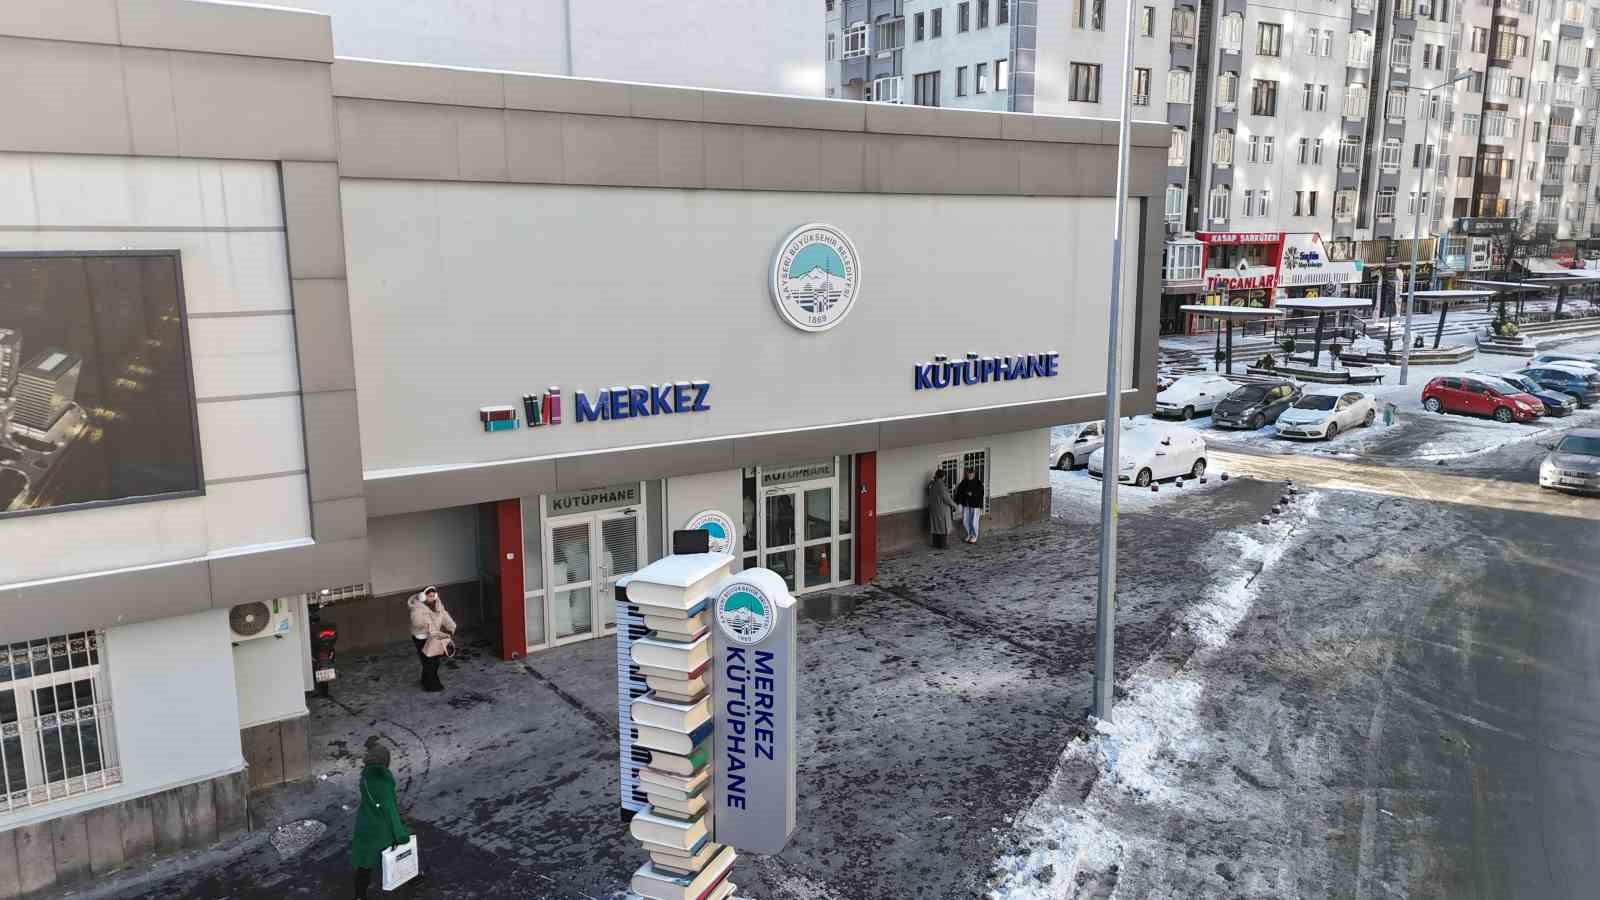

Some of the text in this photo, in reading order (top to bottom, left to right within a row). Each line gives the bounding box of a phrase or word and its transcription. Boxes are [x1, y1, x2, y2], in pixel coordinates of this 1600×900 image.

[575, 352, 1059, 422] MERKEZ KÜTÜPHANE
[726, 647, 751, 810] KÜTÜPHANE
[754, 650, 774, 761] MERKEZ
